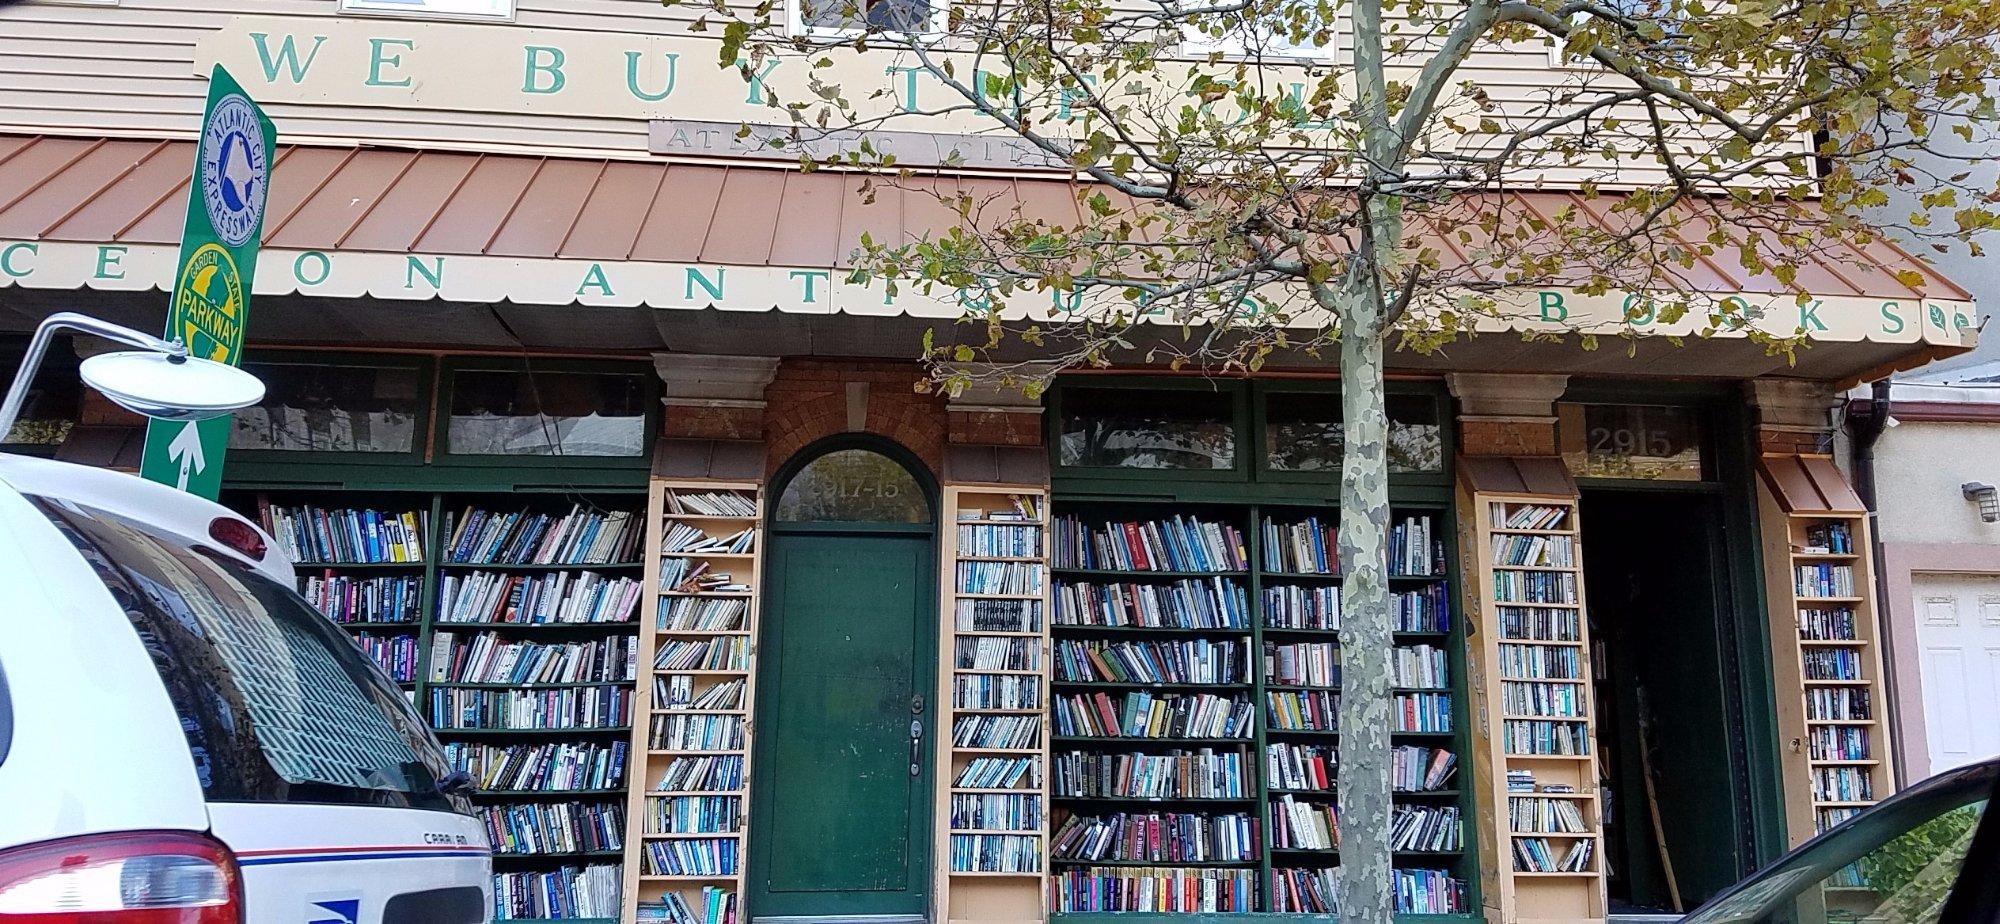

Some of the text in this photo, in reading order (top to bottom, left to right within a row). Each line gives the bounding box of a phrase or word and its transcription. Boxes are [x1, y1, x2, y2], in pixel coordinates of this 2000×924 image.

[249, 32, 1336, 130] WE BUY THE OL
[214, 108, 263, 185] ATLANTIC CITY
[666, 127, 893, 157] ATLANTC
[207, 160, 256, 236] EXPRESSWAY
[191, 250, 241, 309] GARDEN STATE
[293, 251, 445, 290] ON
[1538, 291, 1906, 335] BOOKS
[180, 288, 240, 348] PARKWAY
[1590, 427, 1672, 457] 2915
